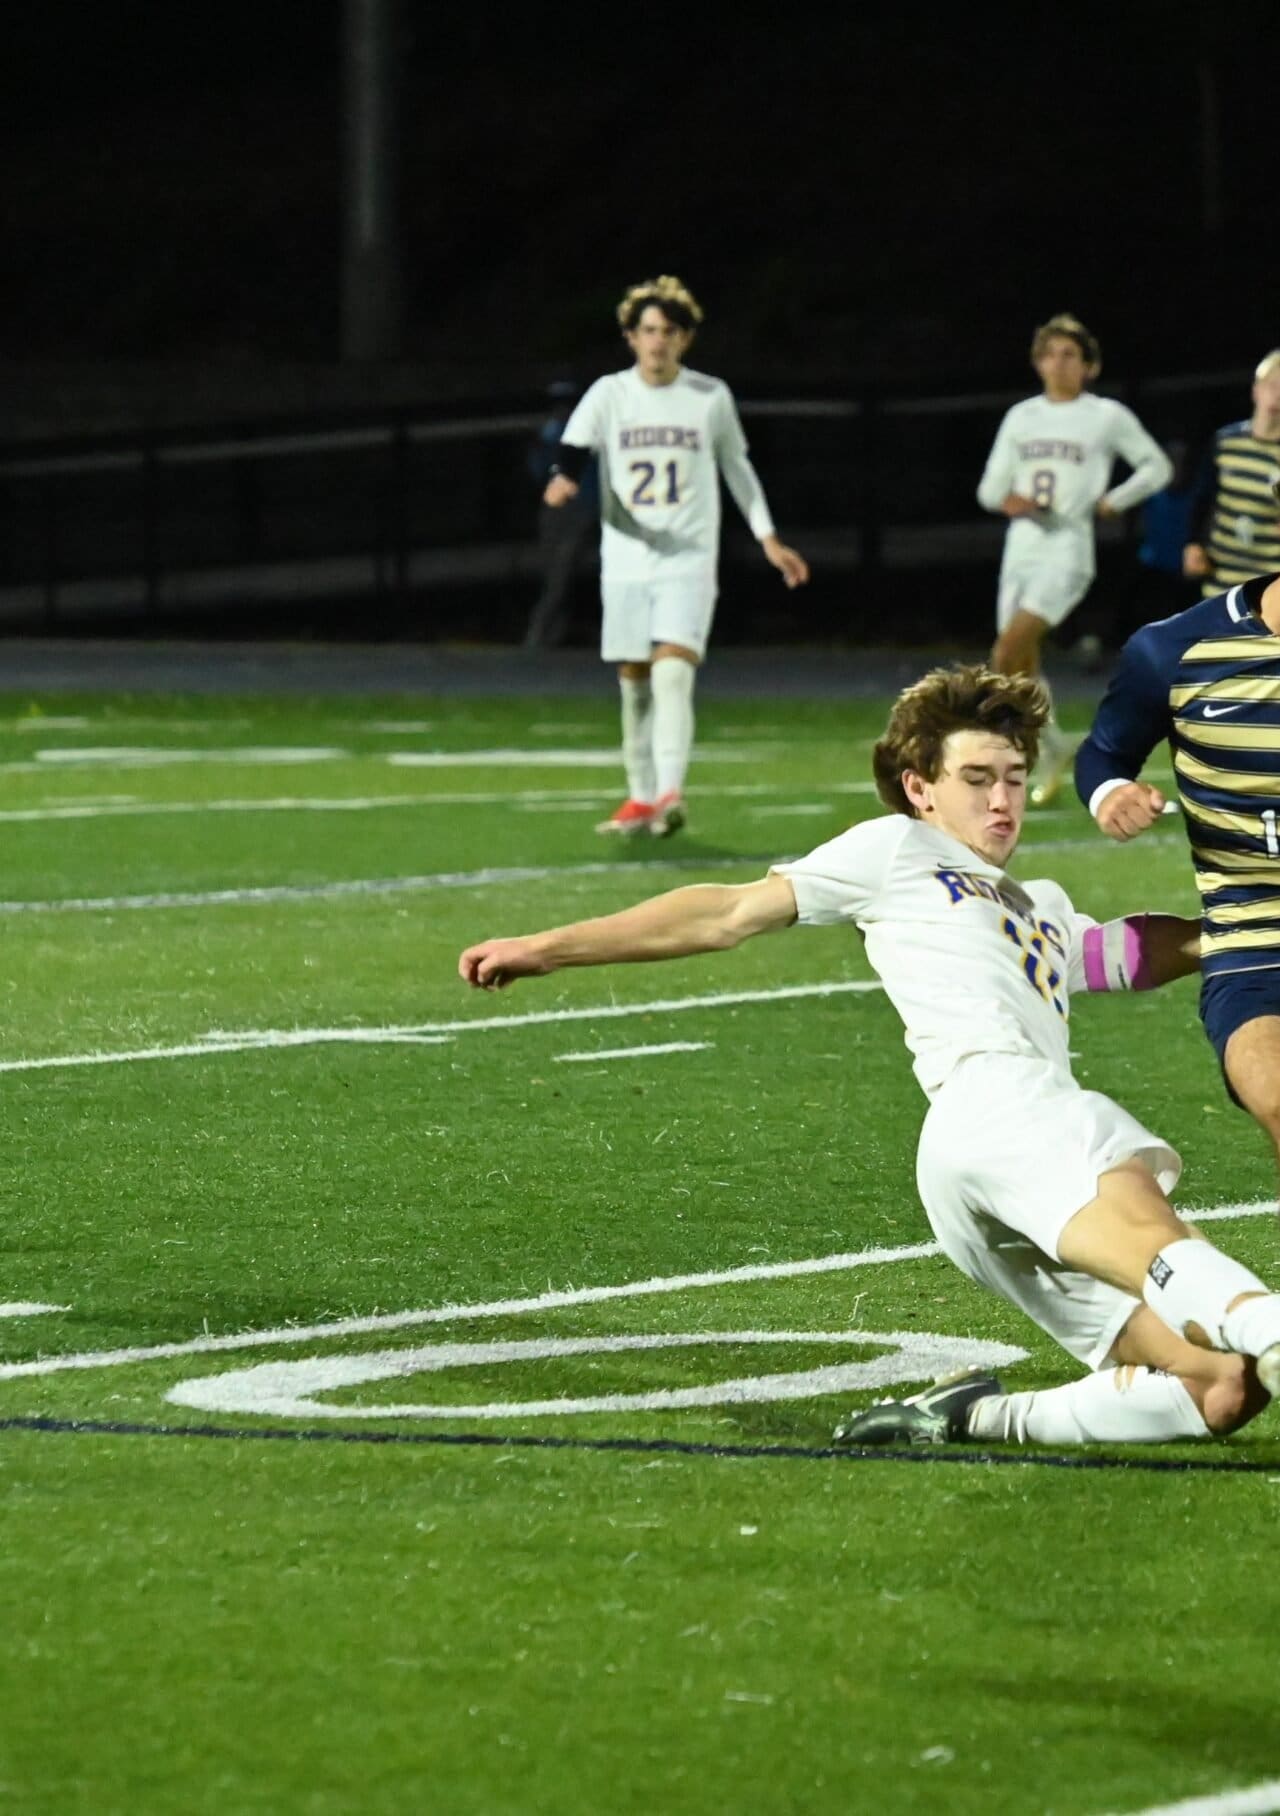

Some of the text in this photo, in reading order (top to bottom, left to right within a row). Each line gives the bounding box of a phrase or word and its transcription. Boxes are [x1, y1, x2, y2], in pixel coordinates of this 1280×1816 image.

[619, 426, 701, 452] RIDERS
[630, 460, 679, 505] 21
[1033, 469, 1056, 513] 8
